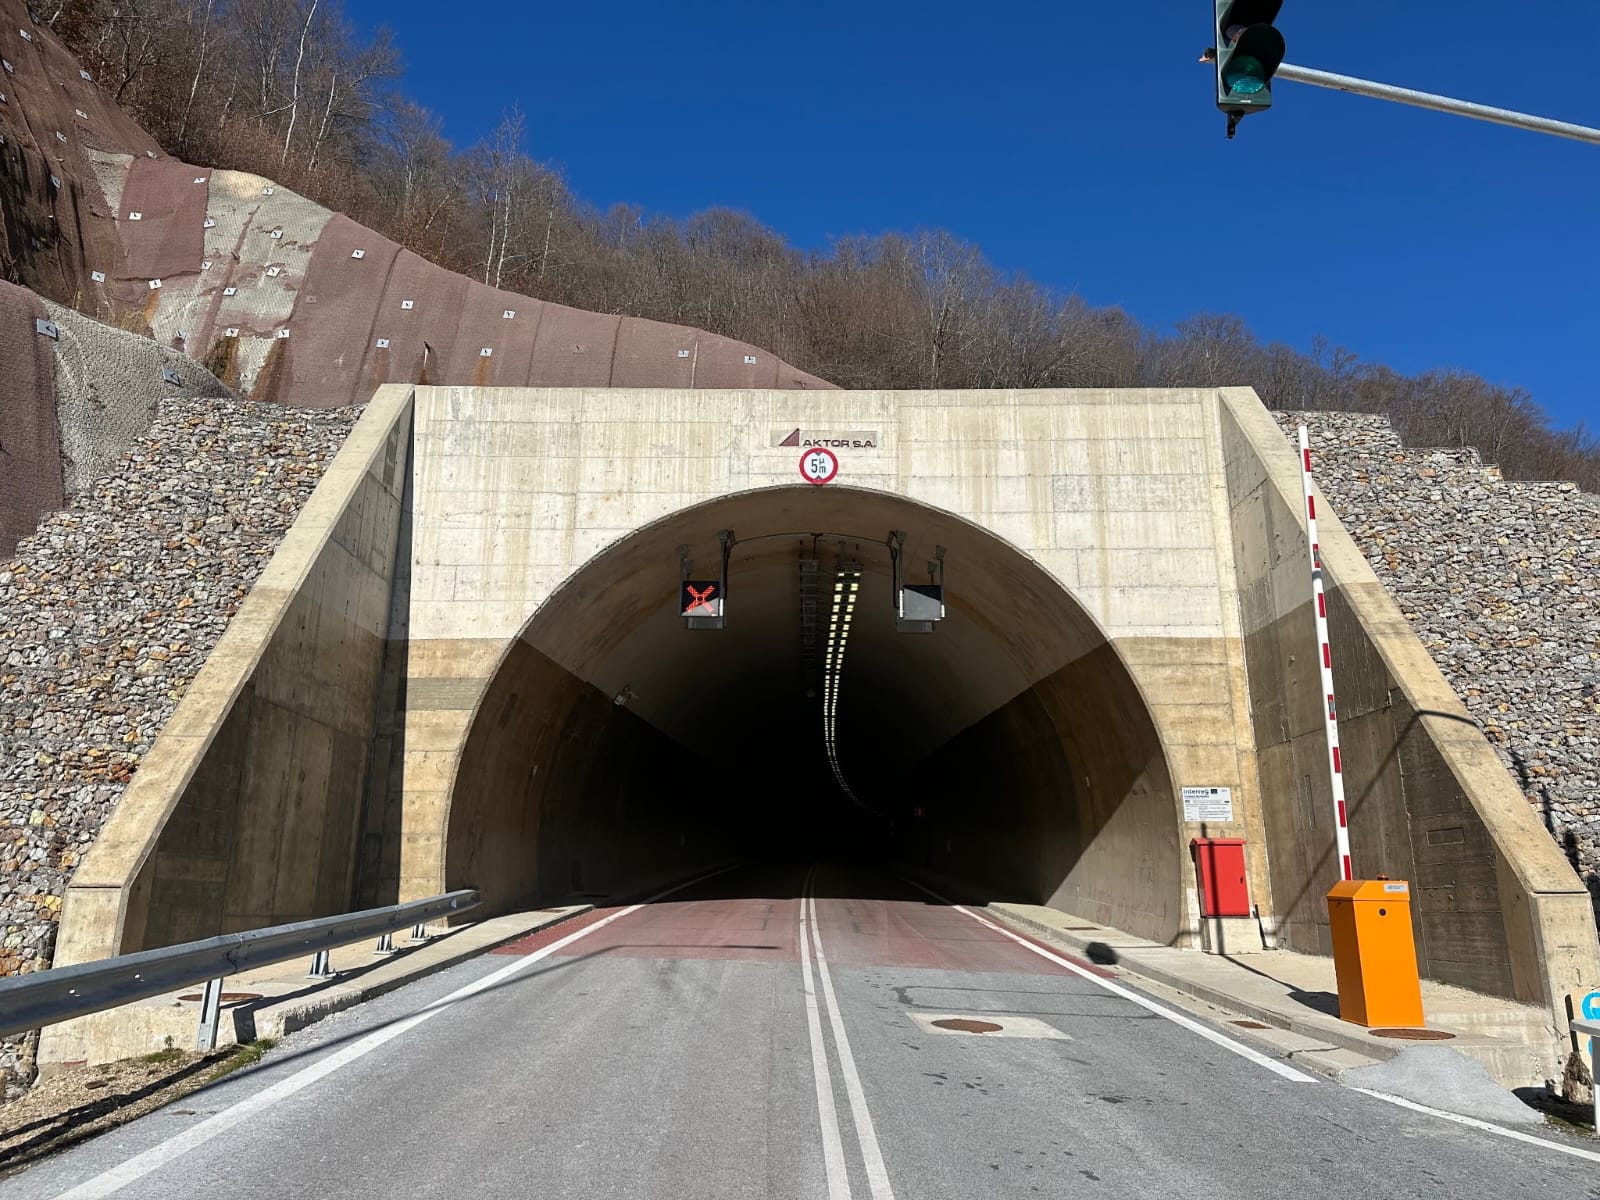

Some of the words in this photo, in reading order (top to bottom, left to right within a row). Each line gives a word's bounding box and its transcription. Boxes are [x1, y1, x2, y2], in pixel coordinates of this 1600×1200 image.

[853, 440, 877, 448] S.A.
[811, 458, 818, 473] 5
[819, 465, 826, 473] m
